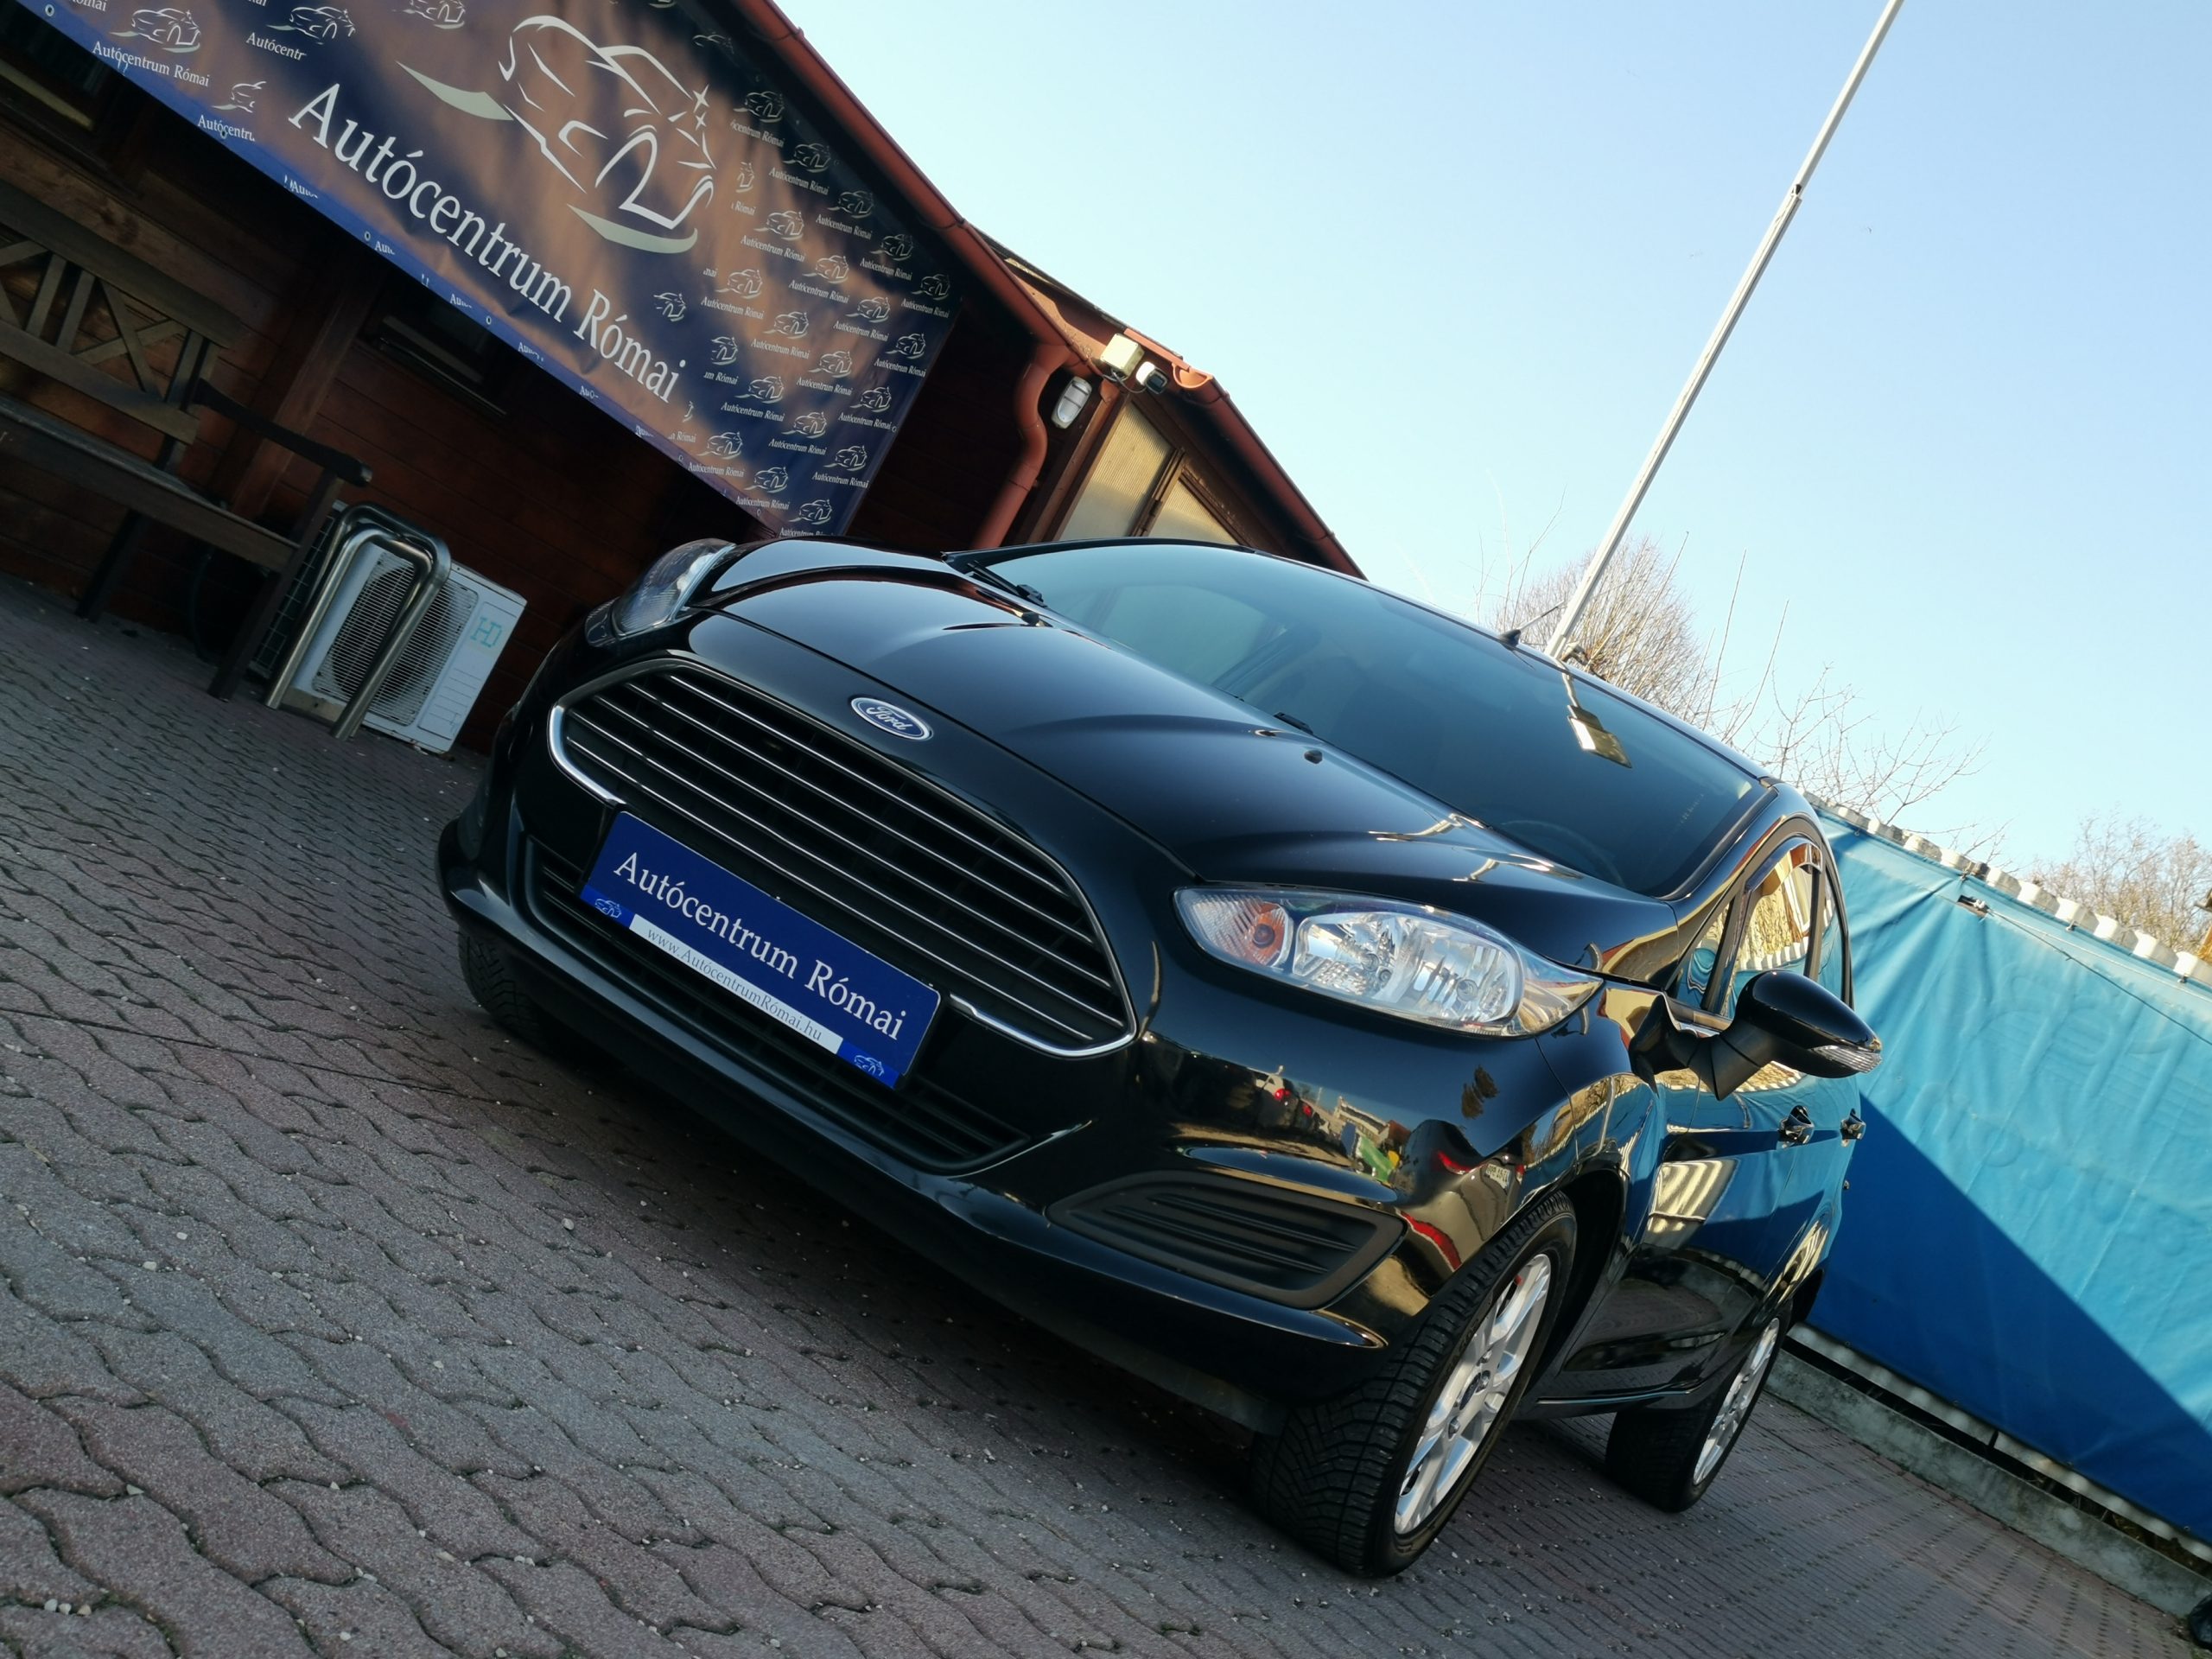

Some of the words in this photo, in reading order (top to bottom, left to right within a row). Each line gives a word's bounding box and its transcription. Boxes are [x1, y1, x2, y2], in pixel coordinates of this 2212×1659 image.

[92, 41, 169, 75] Autócentrum
[174, 64, 210, 86] Római
[761, 130, 785, 148] Római
[769, 167, 809, 189] Autócentrum
[810, 180, 830, 195] Római
[734, 200, 757, 216] Római
[816, 214, 853, 234] Autócentrum
[854, 225, 873, 239] Római
[288, 83, 574, 323] Autócentrum
[573, 289, 687, 404] Római
[741, 235, 784, 257] Autócentrum
[784, 246, 805, 263] Római
[860, 257, 893, 276] Autócentrum
[894, 266, 912, 281] Római
[789, 280, 829, 298] Autócentrum
[829, 288, 849, 304] Római
[701, 296, 743, 315] Autócentrum
[744, 305, 764, 320] Római
[833, 321, 869, 338] Autócentrum
[869, 327, 889, 342] Római
[751, 339, 788, 356] Autócentrum
[789, 345, 810, 359] Római
[715, 372, 739, 385] Római
[874, 358, 907, 374] Autócentrum
[907, 364, 926, 378] Római
[797, 377, 834, 393] Autócentrum
[834, 382, 854, 397] Római
[721, 402, 763, 419] Autócentrum
[764, 409, 785, 423] Római
[838, 412, 873, 428] Autócentrum
[873, 417, 892, 431] Római
[768, 438, 808, 454] Autócentrum
[808, 442, 827, 456] Római
[688, 462, 725, 476] Autócentrum
[726, 465, 745, 479] Római
[812, 472, 849, 486] Autócentrum
[849, 475, 868, 489] Római
[770, 499, 791, 511] Római
[866, 706, 913, 731] Ford
[613, 852, 798, 979] Autócentrum
[804, 959, 906, 1040] Római
[647, 929, 823, 1042] www.AutócentrumRómai.hu
